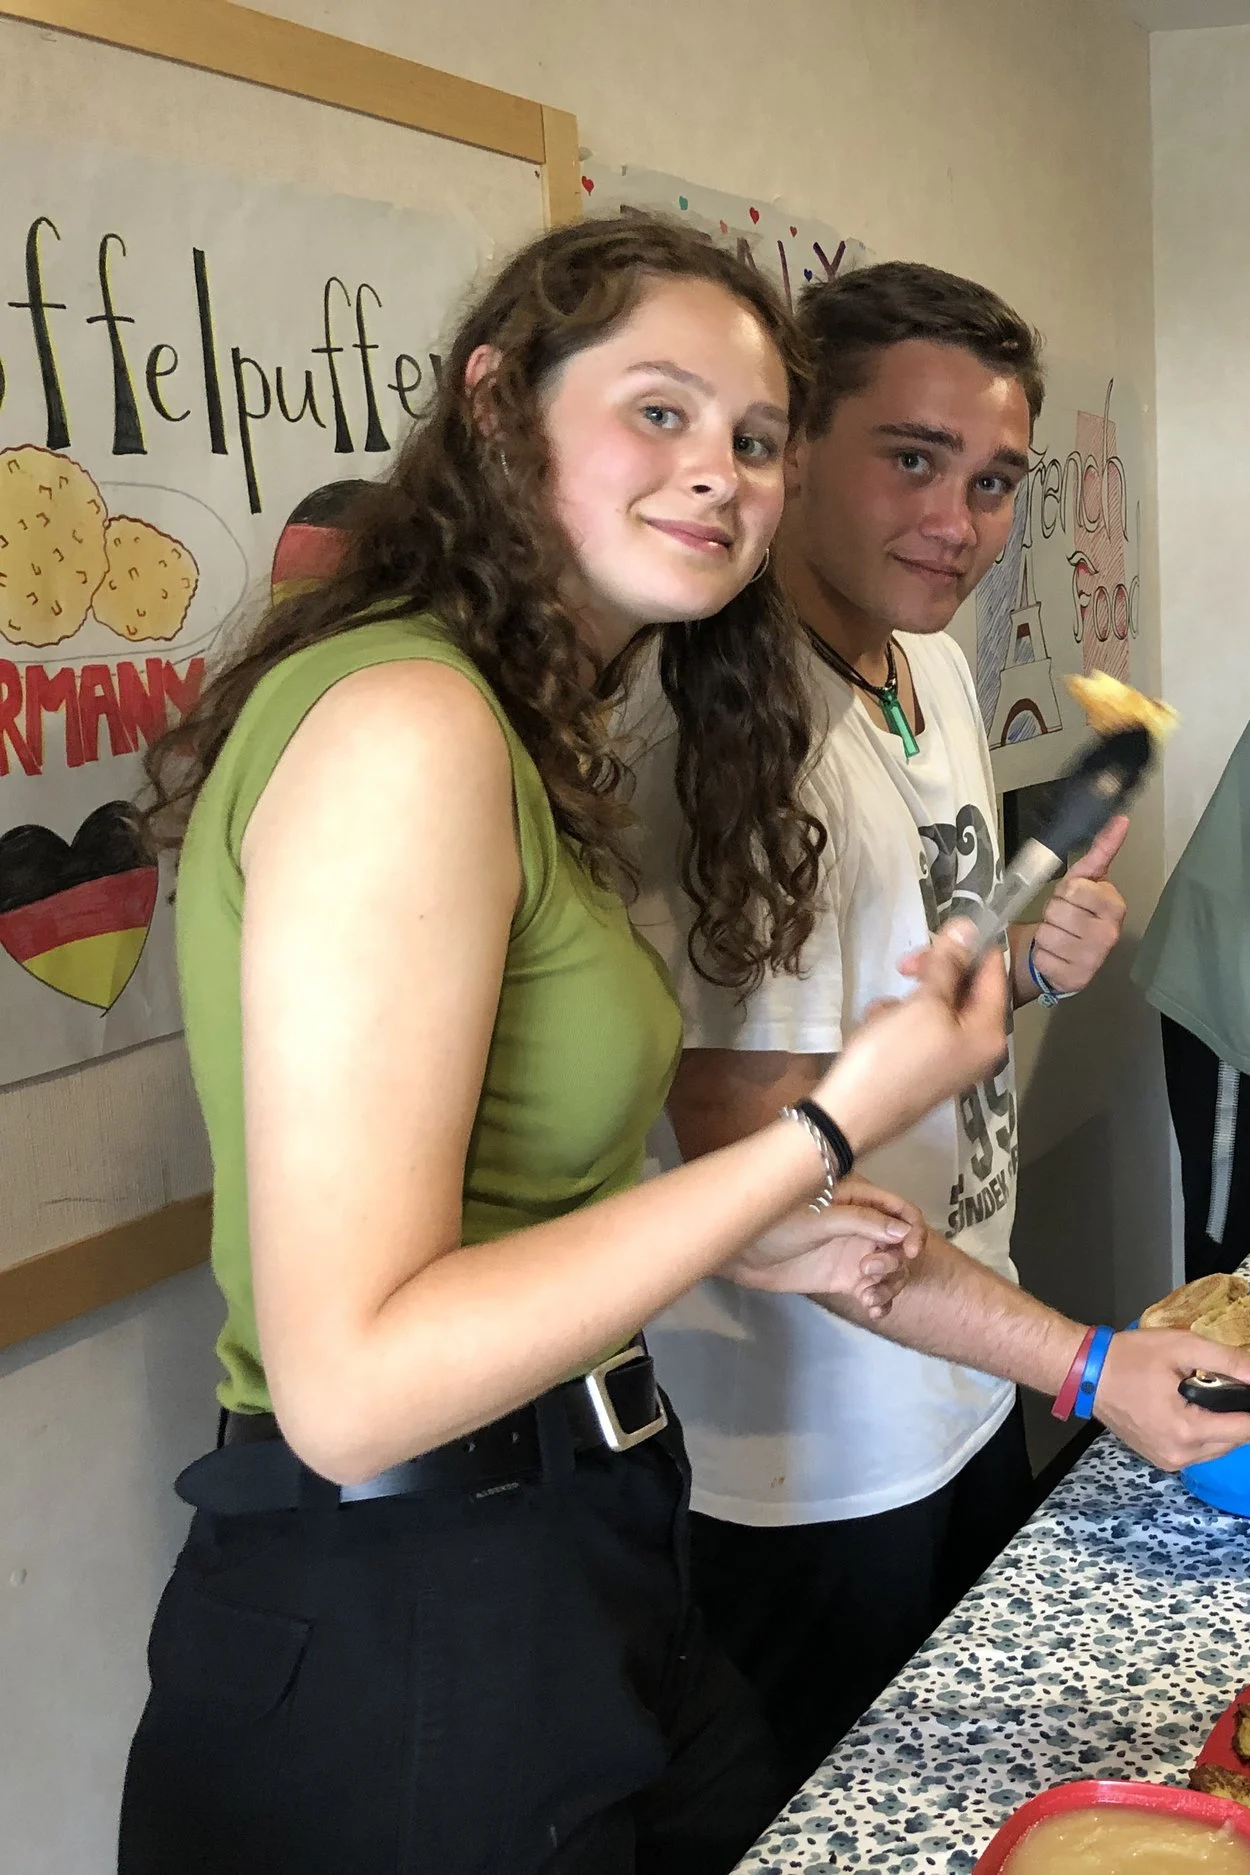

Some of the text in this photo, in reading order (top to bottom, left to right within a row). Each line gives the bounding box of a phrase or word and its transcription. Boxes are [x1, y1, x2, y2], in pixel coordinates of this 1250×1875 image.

[0, 216, 443, 514] ffelpuffe
[1018, 377, 1129, 553] rench
[0, 656, 205, 777] RMANY
